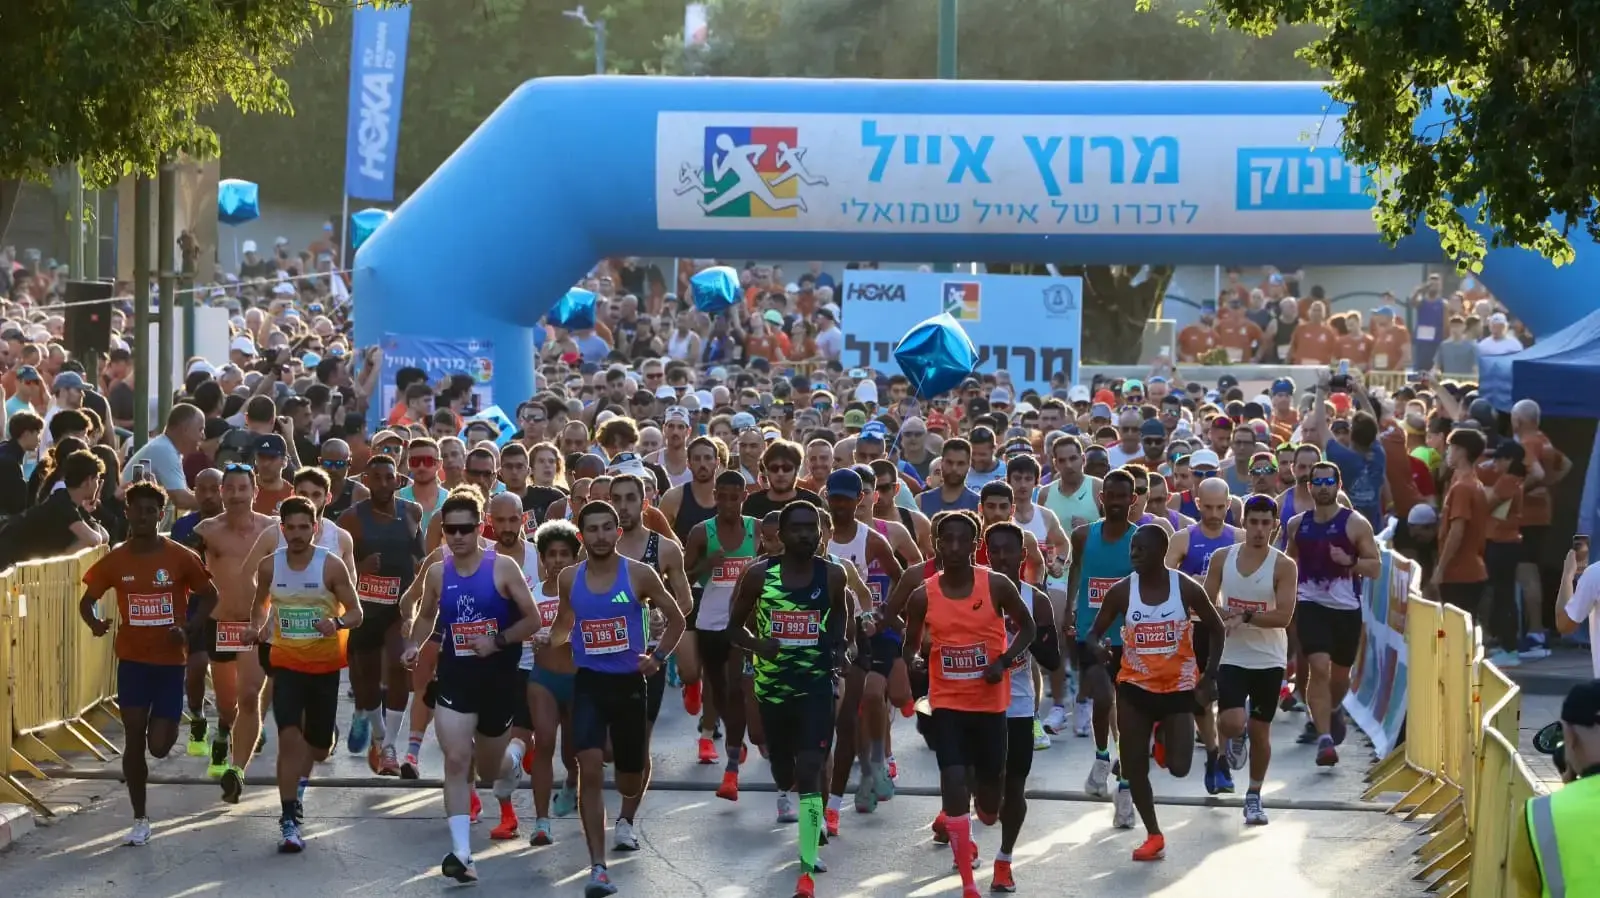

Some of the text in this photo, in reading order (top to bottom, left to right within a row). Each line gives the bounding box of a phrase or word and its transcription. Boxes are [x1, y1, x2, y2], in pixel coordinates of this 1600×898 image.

[357, 73, 394, 182] HOKA
[861, 119, 1180, 197] מרוץ אייל
[841, 197, 1200, 225] לזכרו של אייל שמואלי
[846, 282, 907, 304] HOKA
[384, 354, 466, 372] מרוץ אייל
[141, 604, 160, 614] 1001
[787, 622, 805, 633] 993
[596, 630, 612, 642] 195
[1146, 632, 1165, 642] 1222
[955, 656, 973, 667] 1071
